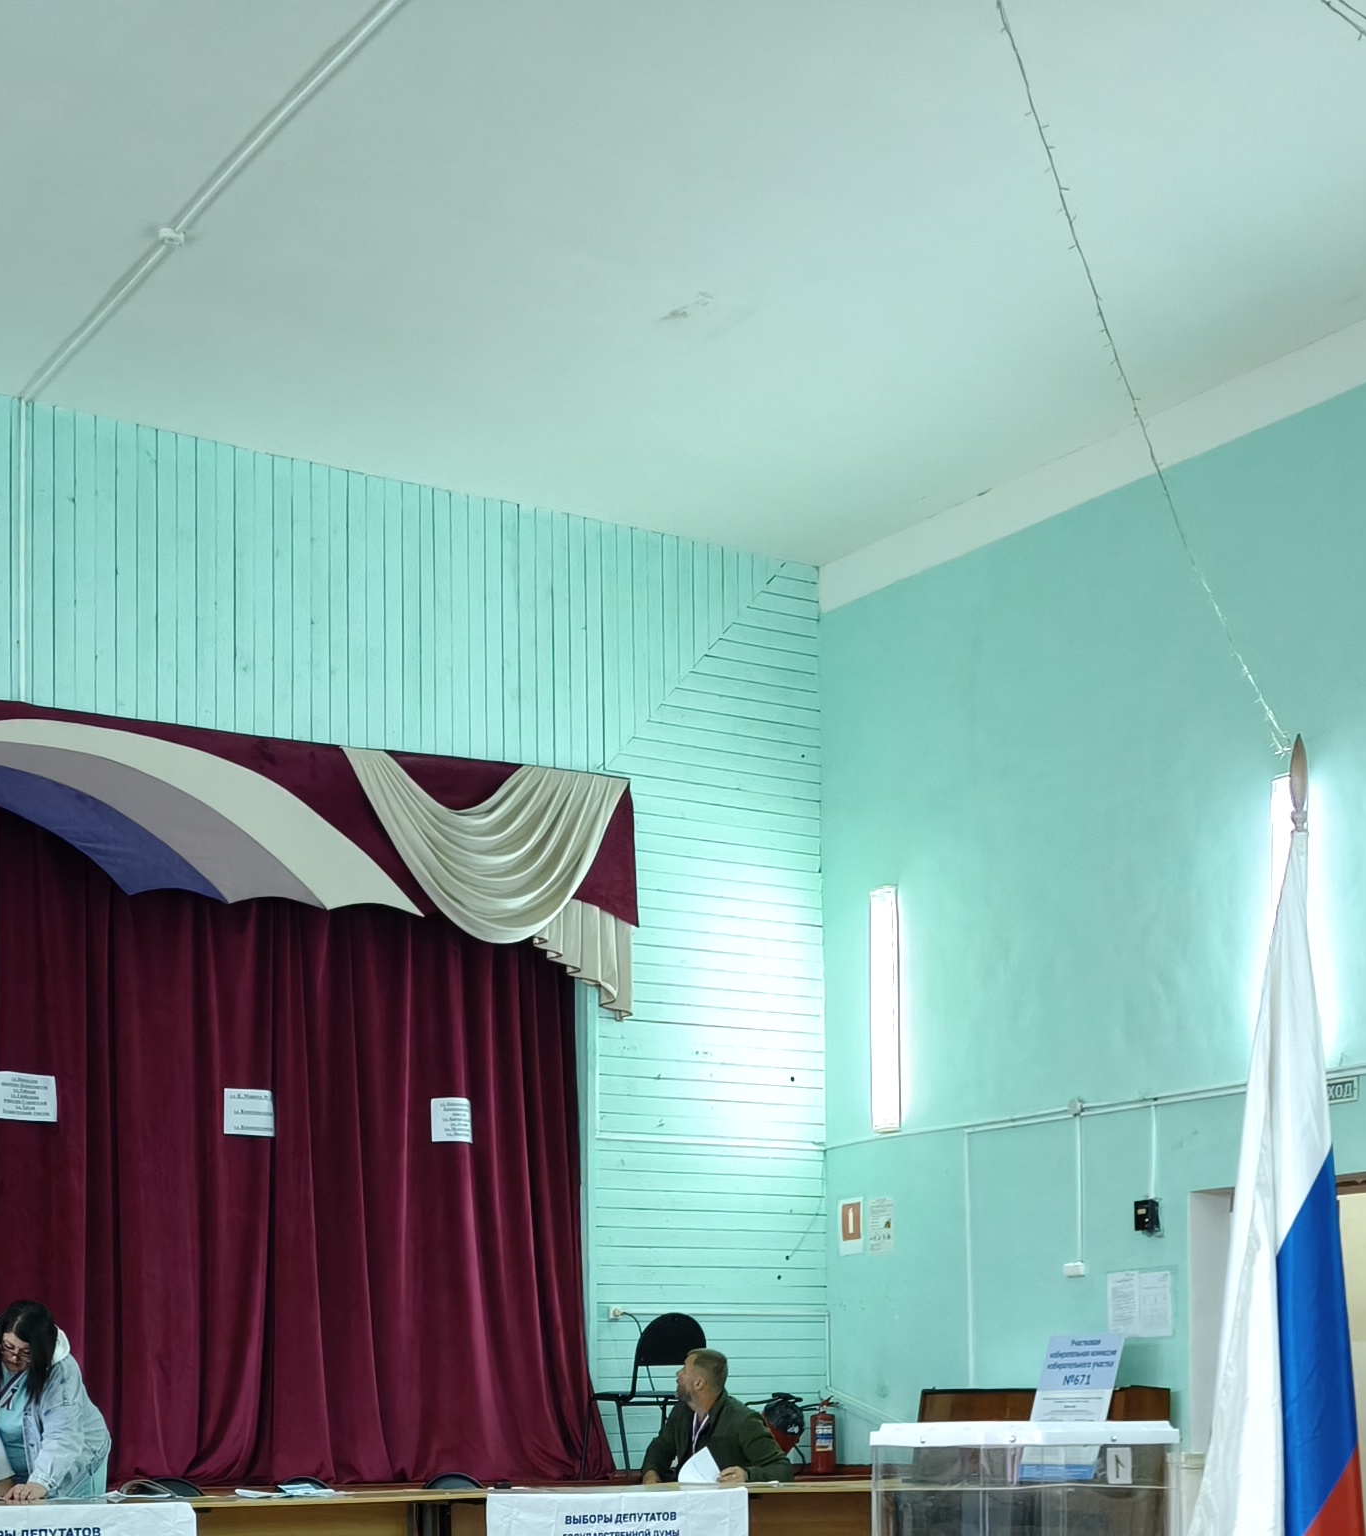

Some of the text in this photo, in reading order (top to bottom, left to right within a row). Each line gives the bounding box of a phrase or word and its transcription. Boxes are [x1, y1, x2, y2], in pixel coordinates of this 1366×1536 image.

[1326, 1083, 1353, 1099] ХОД
[565, 1511, 677, 1525] ВЫБОРЫ ДЕПУТАТОВ
